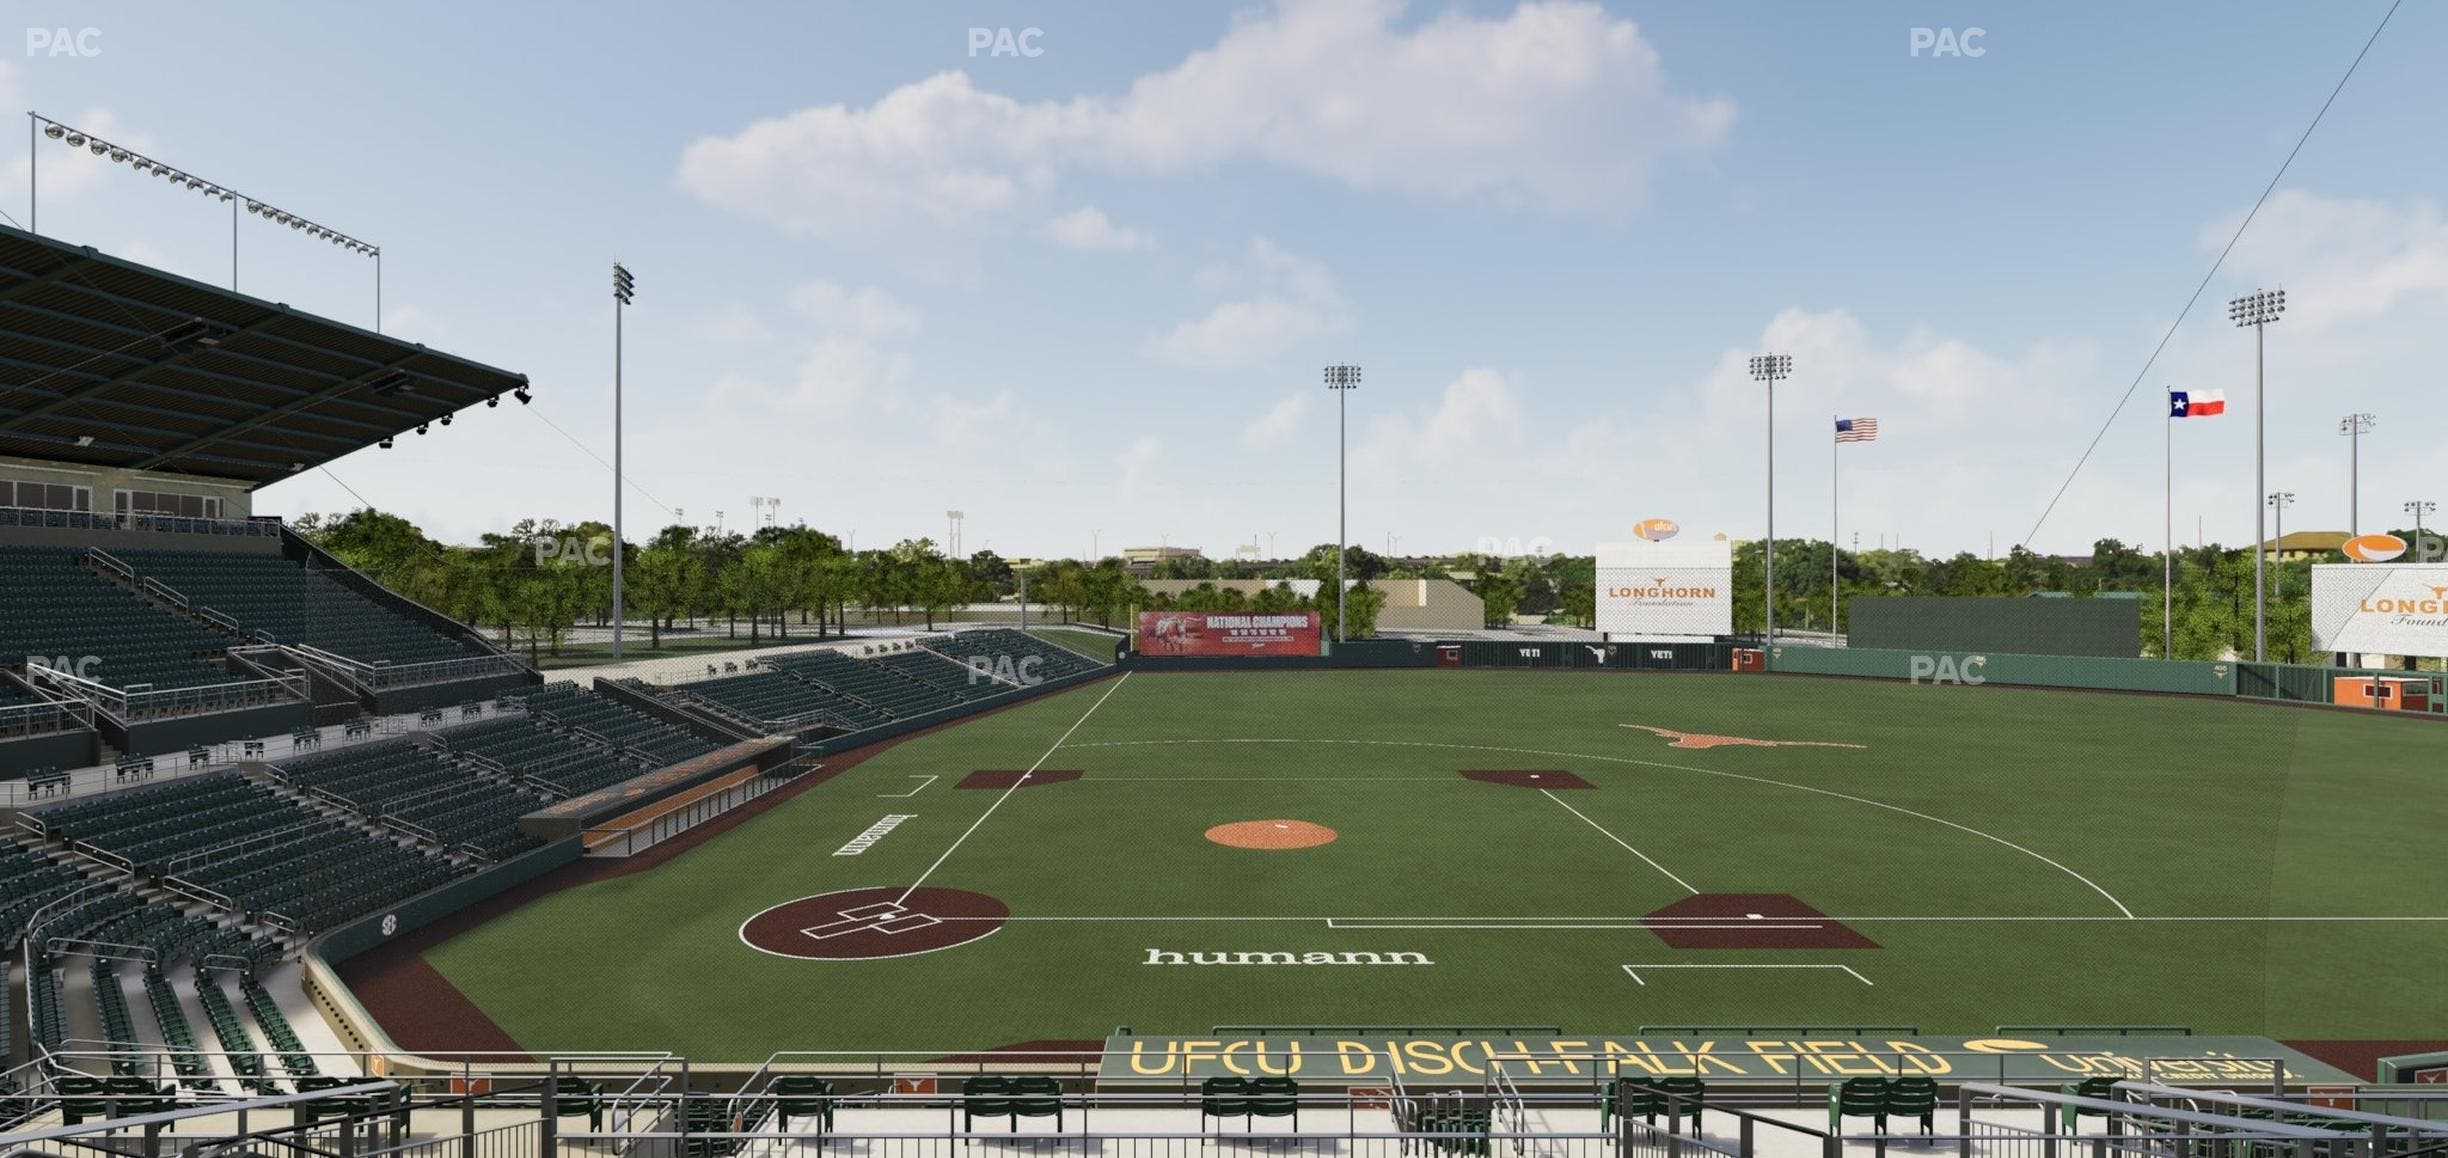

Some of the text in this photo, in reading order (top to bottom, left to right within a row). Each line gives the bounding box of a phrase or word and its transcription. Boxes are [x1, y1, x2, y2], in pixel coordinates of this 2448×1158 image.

[1609, 587, 1716, 598] LONGHORN
[1206, 615, 1309, 629] NATIONAL CHAMPIONS
[1520, 648, 1540, 658] YETI
[1650, 649, 1673, 659] YETI
[1142, 948, 1435, 965] humann
[1130, 1040, 1302, 1075] UFCU
[1746, 1040, 1952, 1075] FIELD
